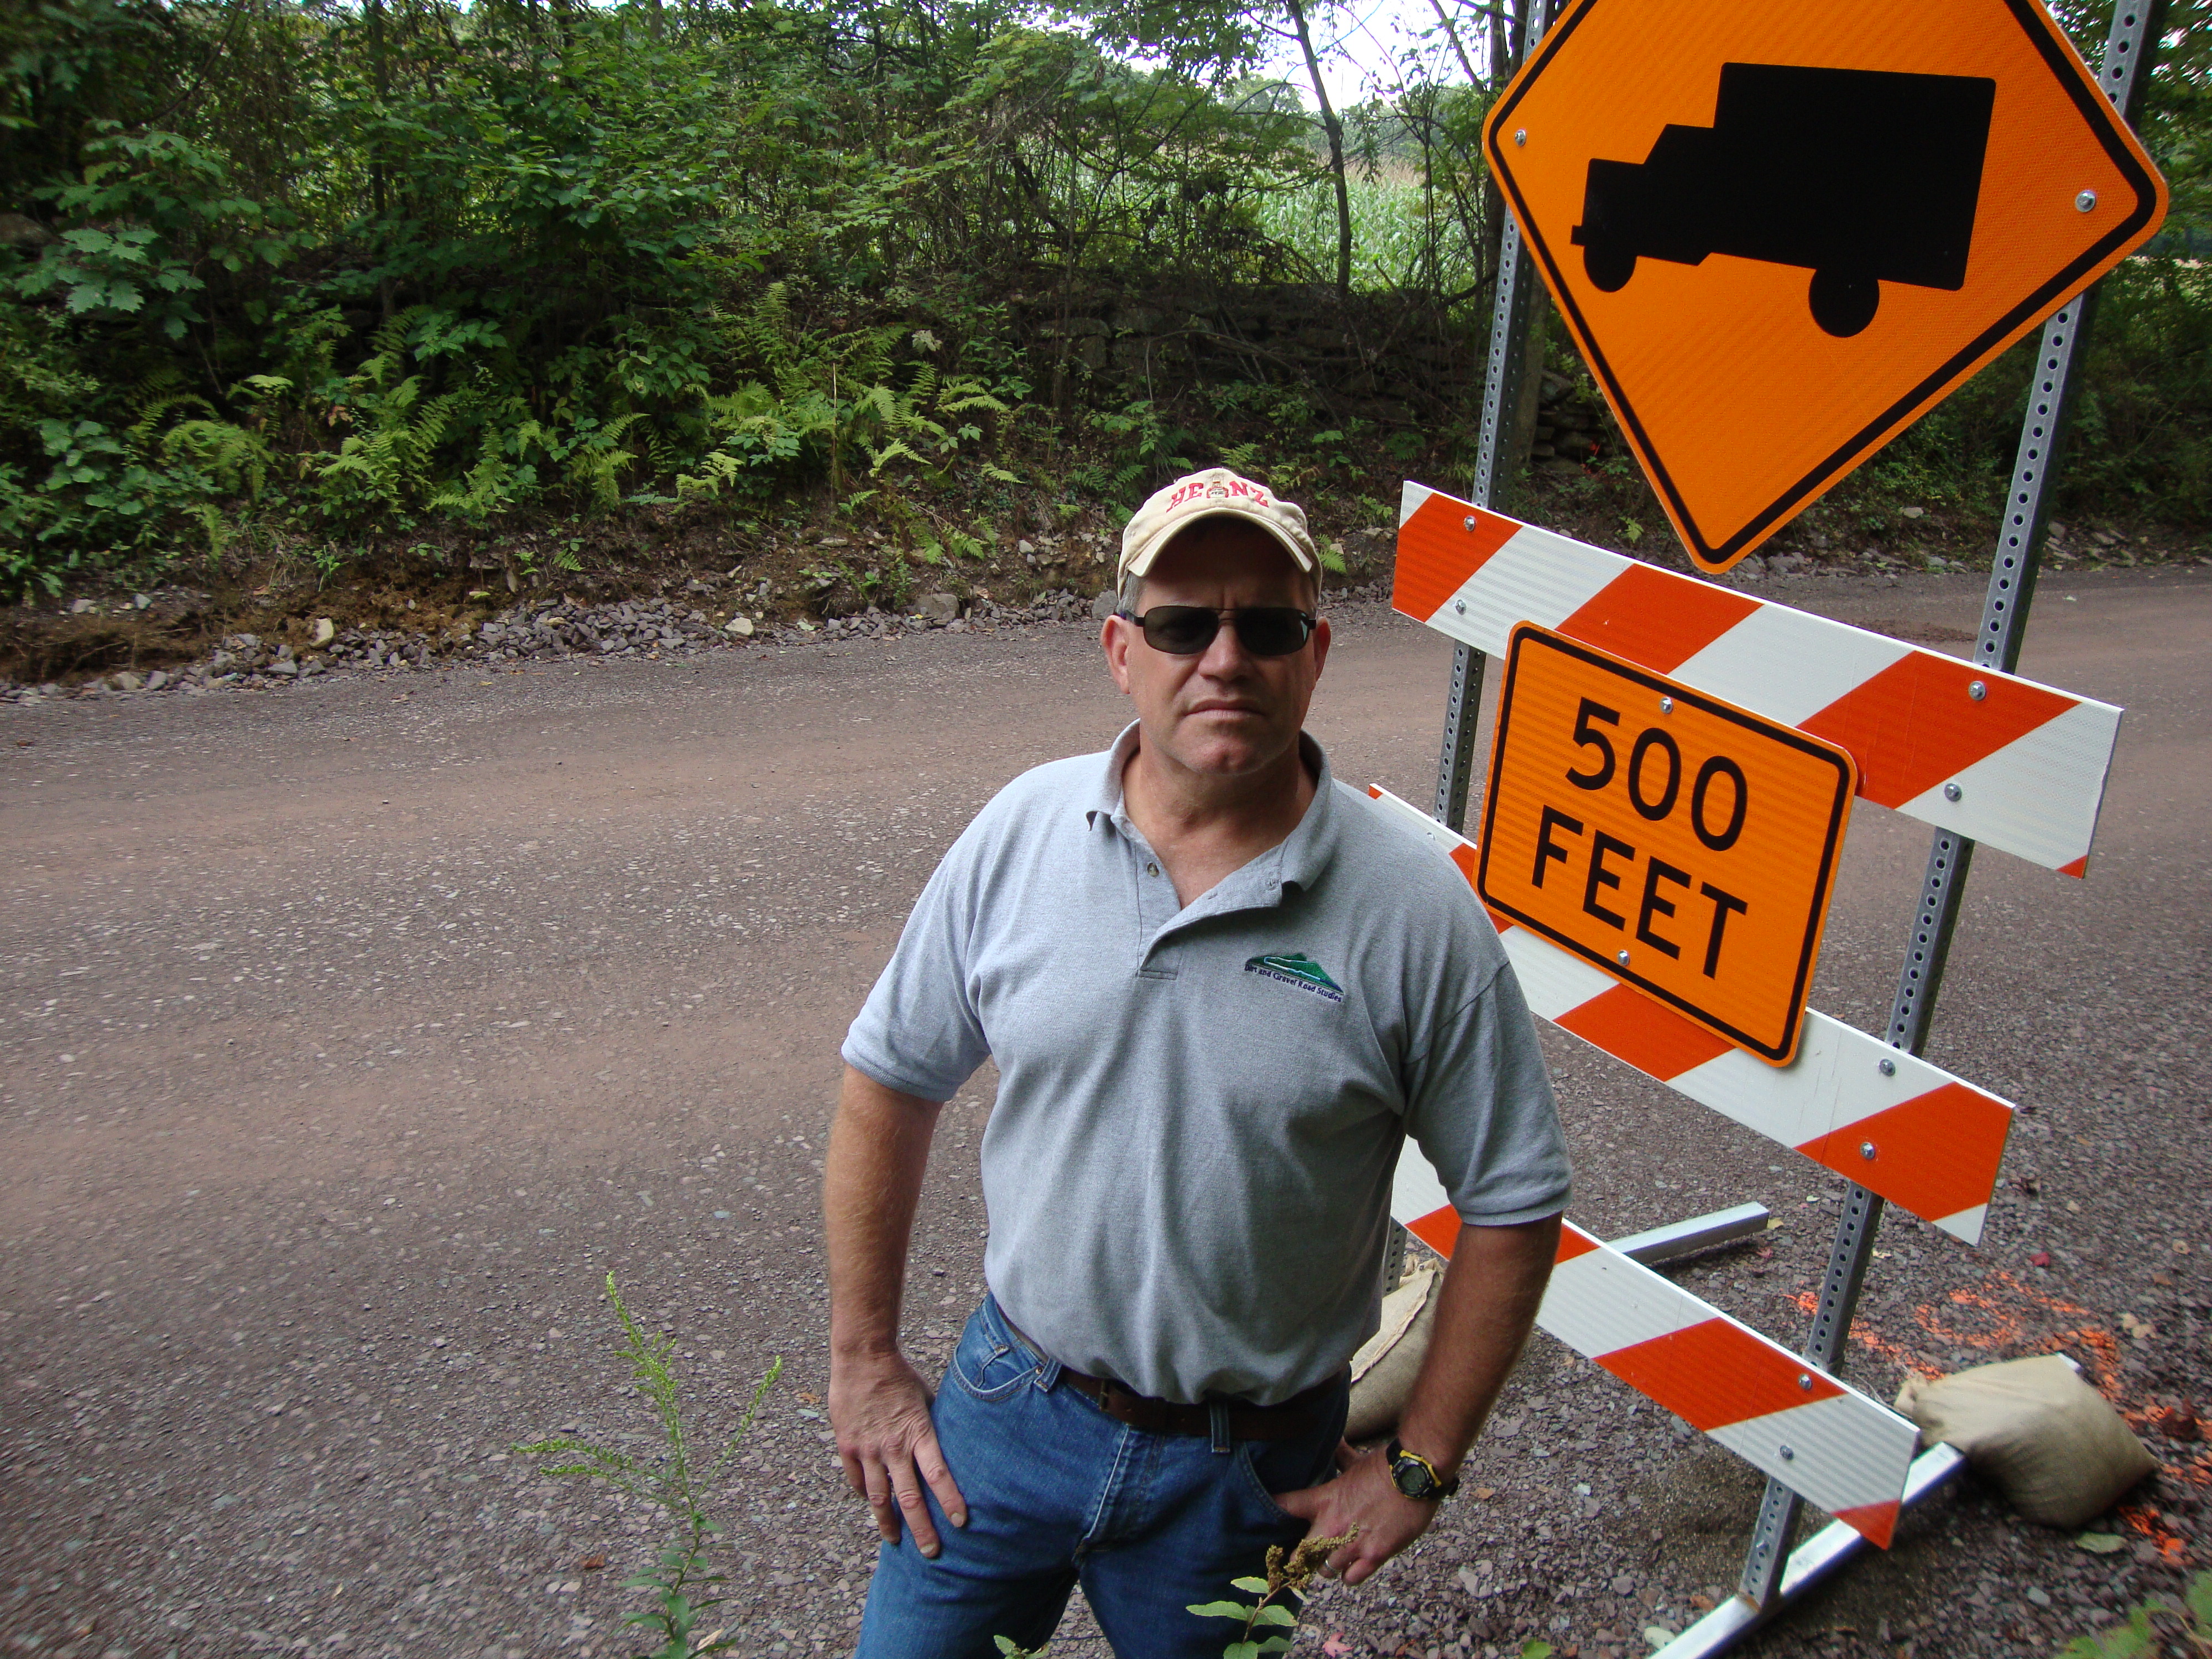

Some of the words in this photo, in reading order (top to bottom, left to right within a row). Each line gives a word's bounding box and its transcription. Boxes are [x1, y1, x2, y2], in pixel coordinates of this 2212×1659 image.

[1566, 696, 1747, 852] 500
[1531, 804, 1747, 980] FEET
[1259, 968, 1271, 978] and
[1273, 972, 1296, 985] Gravel
[1298, 980, 1316, 992] Road
[1317, 987, 1342, 1002] Studies
